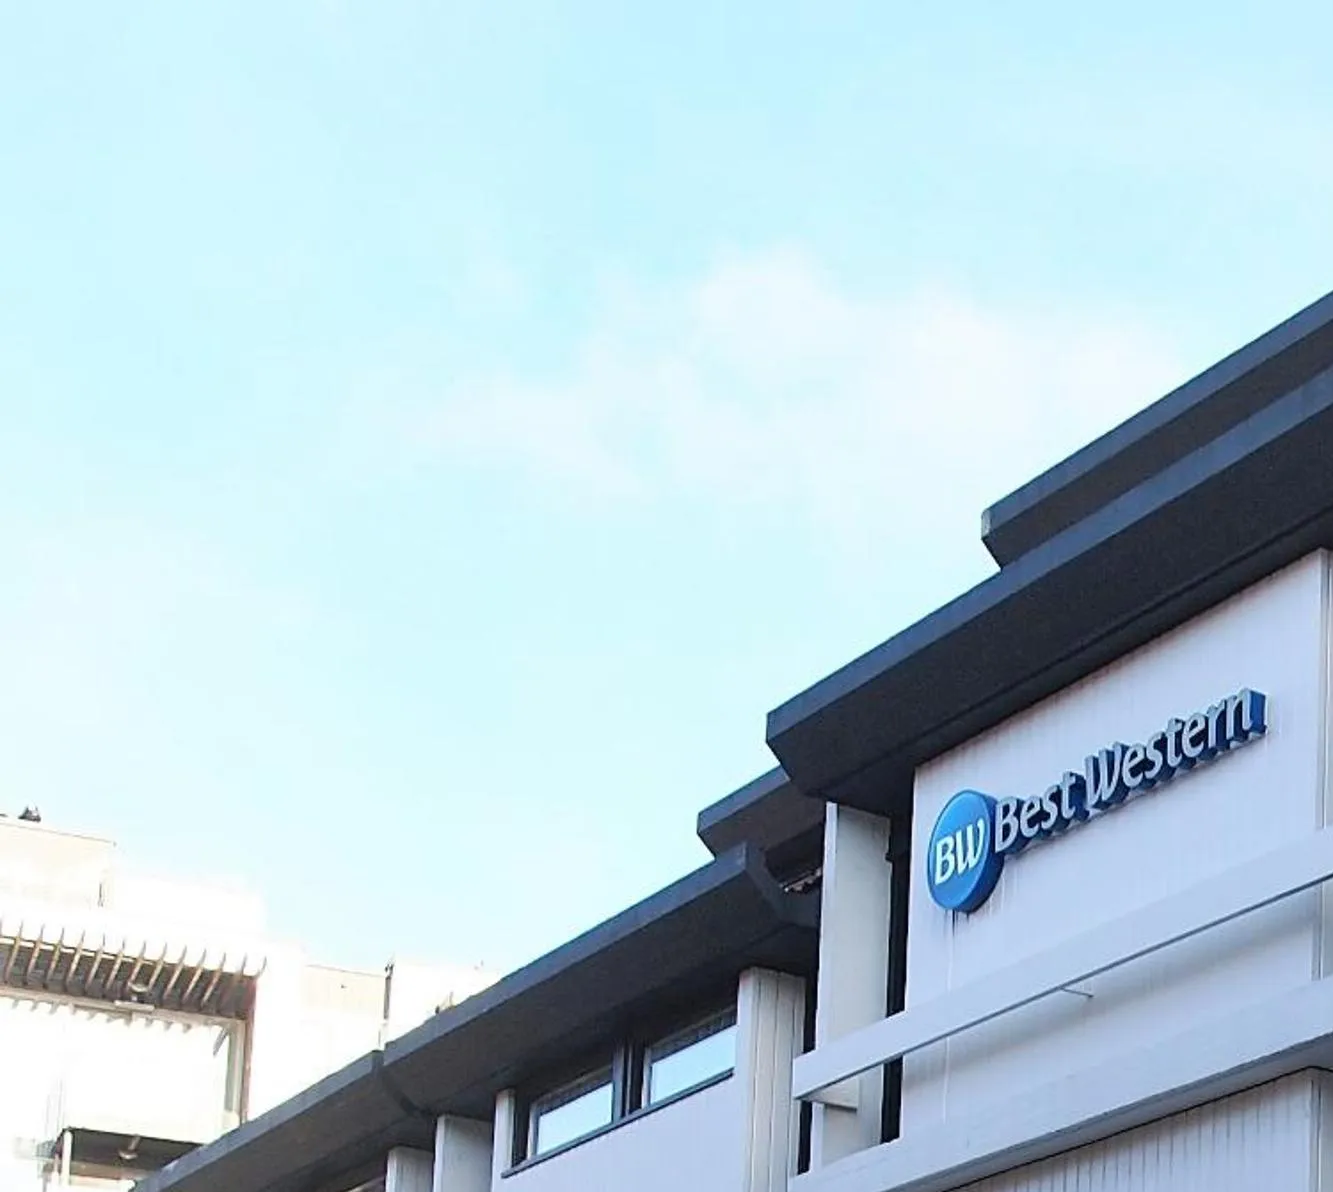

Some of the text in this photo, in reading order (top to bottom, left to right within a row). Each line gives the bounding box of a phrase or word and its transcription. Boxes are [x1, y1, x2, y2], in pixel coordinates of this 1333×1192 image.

[994, 687, 1266, 854] Best Western
[934, 817, 986, 886] BW
